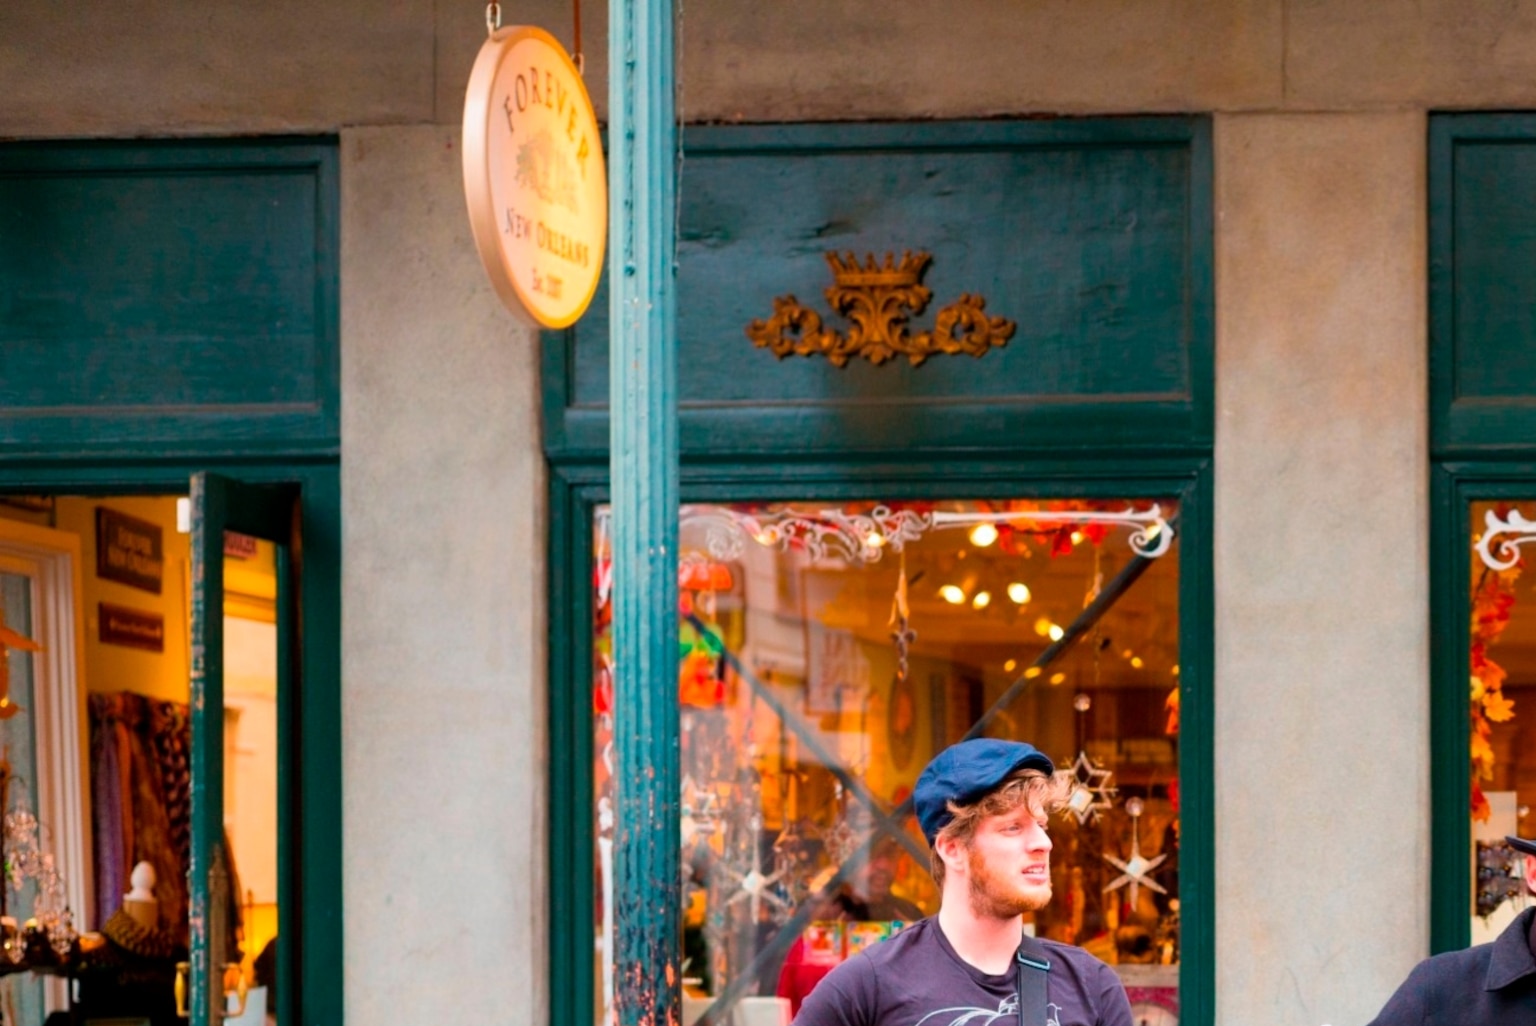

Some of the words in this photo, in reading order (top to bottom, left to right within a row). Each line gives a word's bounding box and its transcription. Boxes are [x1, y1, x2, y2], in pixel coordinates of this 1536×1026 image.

[503, 66, 589, 180] FOREVER
[504, 207, 532, 240] NEW
[536, 221, 590, 269] ORLEANS
